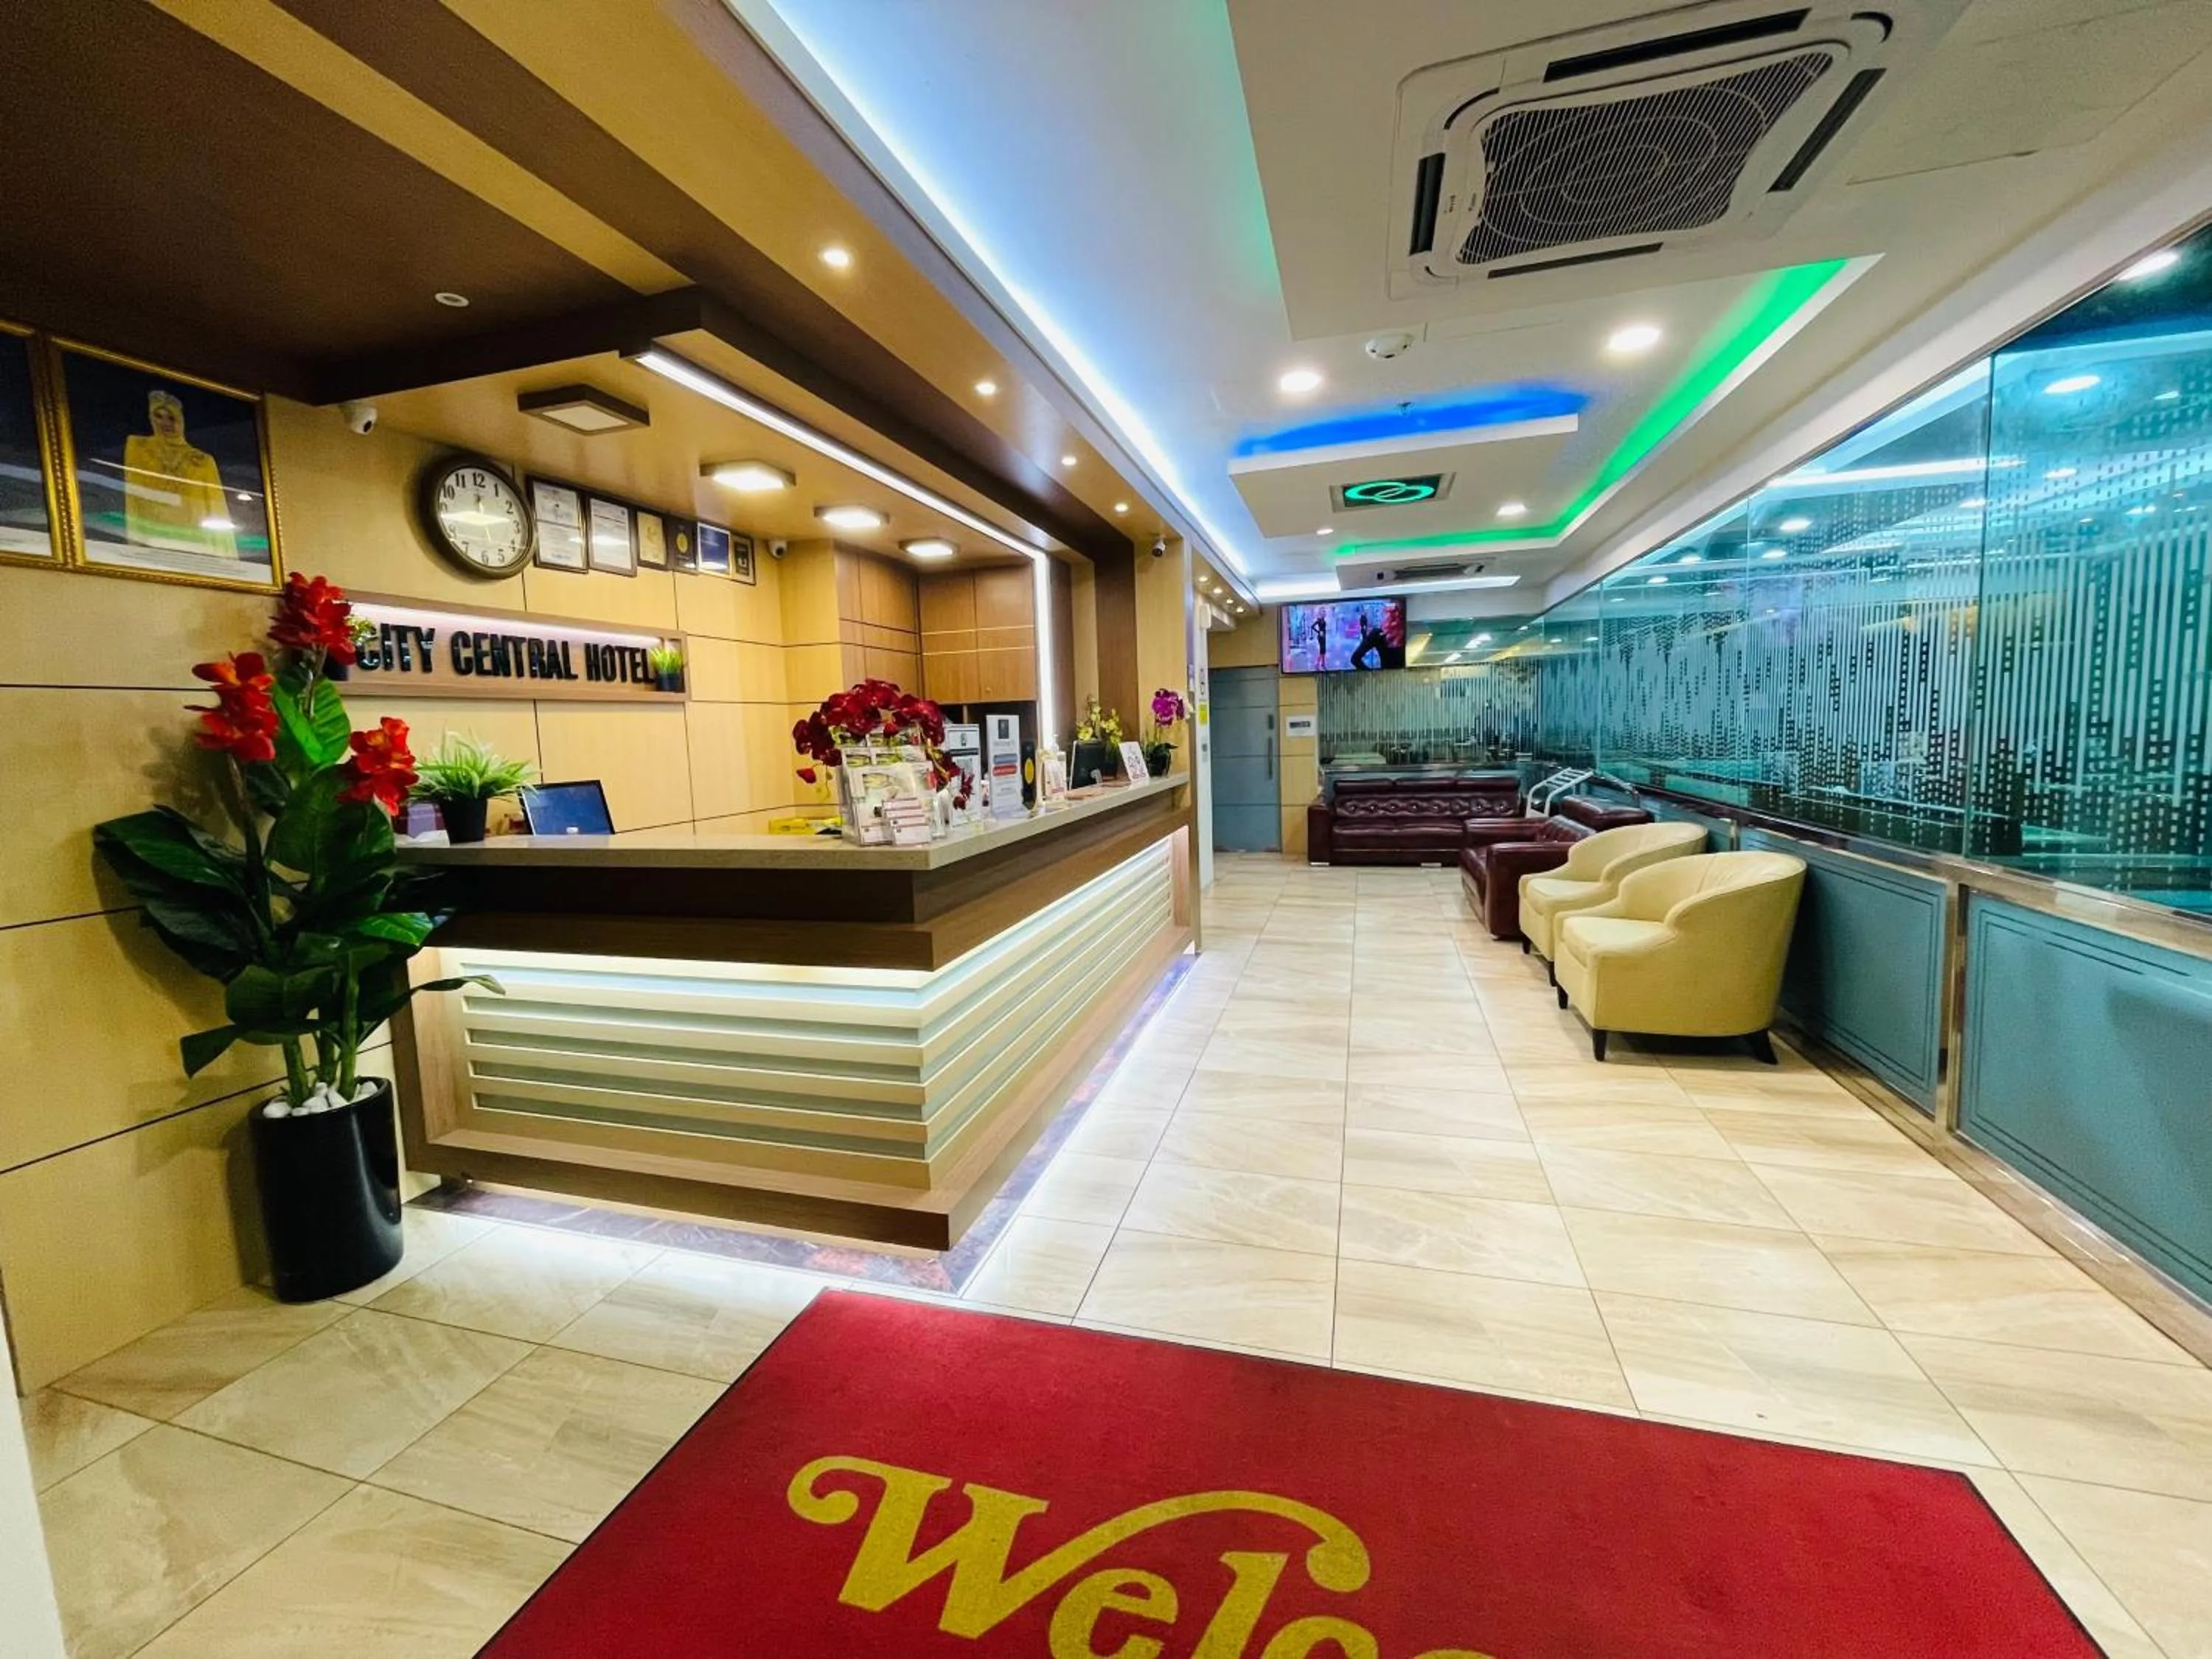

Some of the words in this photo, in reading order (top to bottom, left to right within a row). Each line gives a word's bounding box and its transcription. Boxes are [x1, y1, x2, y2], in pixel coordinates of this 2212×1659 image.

[455, 473, 466, 488] 11
[473, 472, 485, 488] 12
[443, 484, 454, 500] 10
[494, 484, 498, 497] 1
[505, 500, 513, 514] 2
[512, 520, 520, 535] 3
[498, 548, 504, 563] 5
[355, 624, 436, 672] CITY
[451, 630, 578, 679] CENTRAL
[585, 643, 657, 684] HOTEL
[787, 1455, 1498, 1659] Wel
